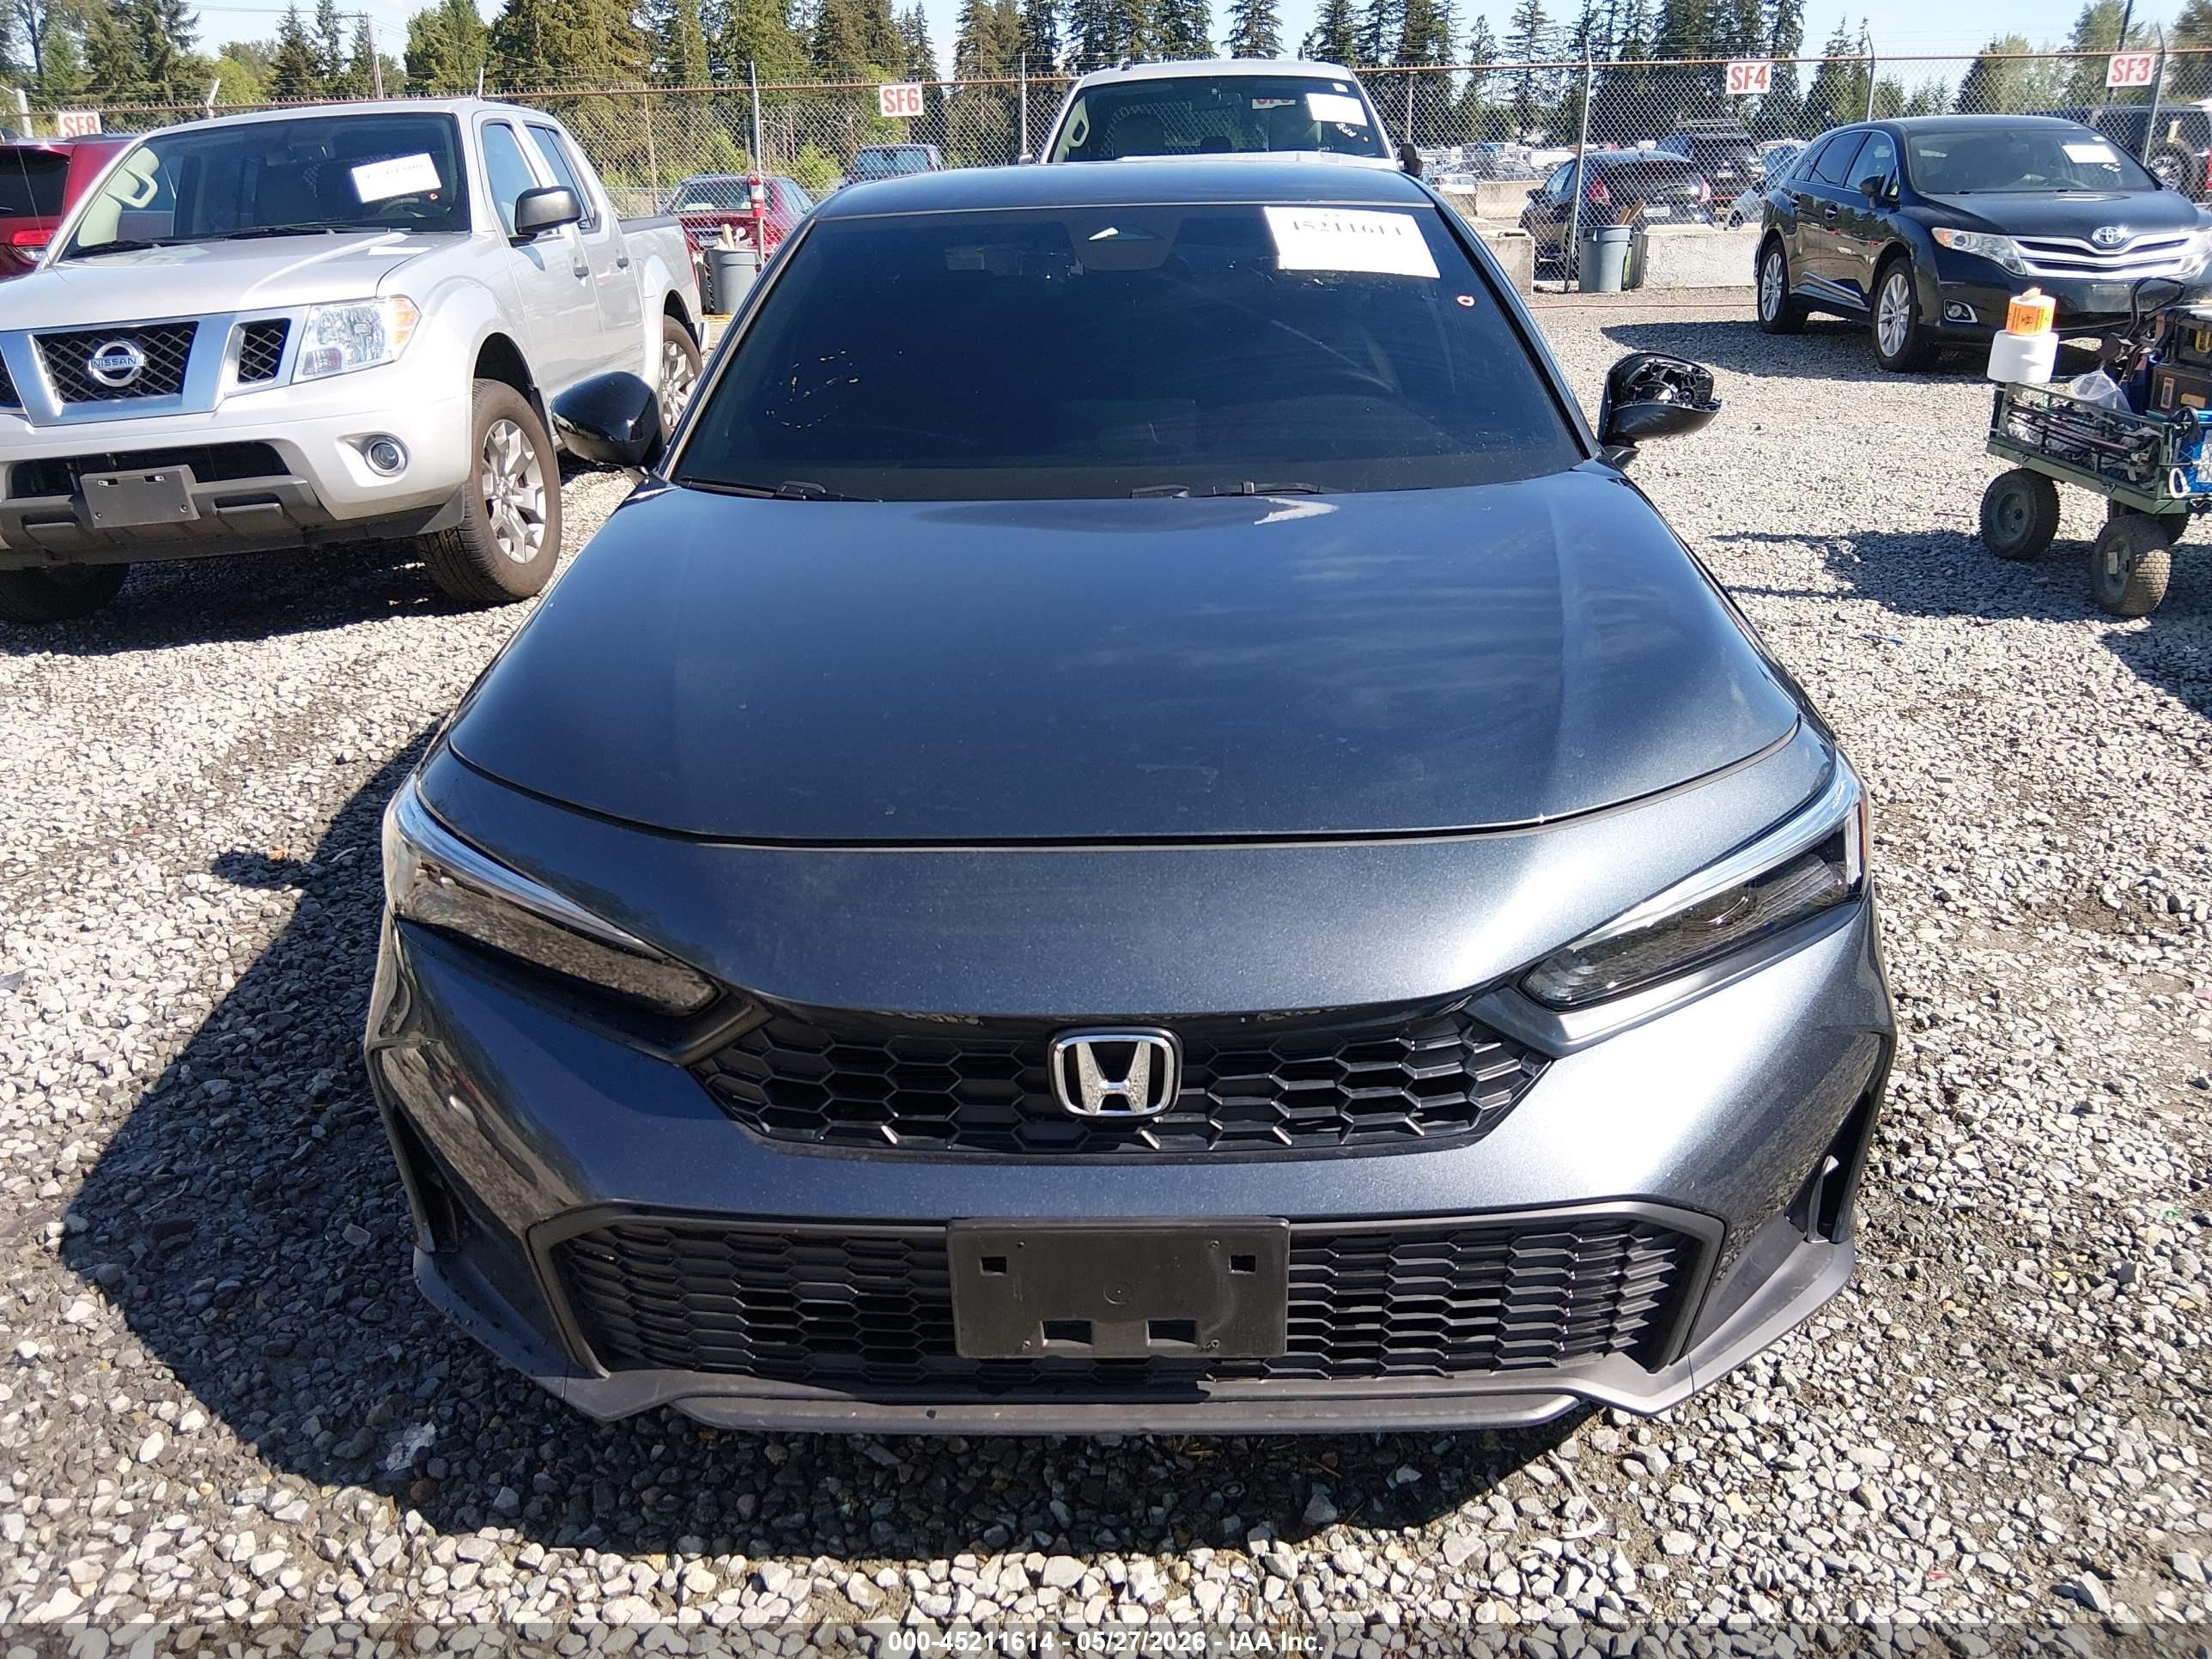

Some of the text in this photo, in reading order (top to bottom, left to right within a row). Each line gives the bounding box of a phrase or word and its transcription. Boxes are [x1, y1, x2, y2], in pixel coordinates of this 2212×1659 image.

[1730, 65, 1767, 90] SF4
[2112, 57, 2150, 83] SF3
[883, 88, 920, 112] SF6
[91, 357, 137, 368] NISSAN
